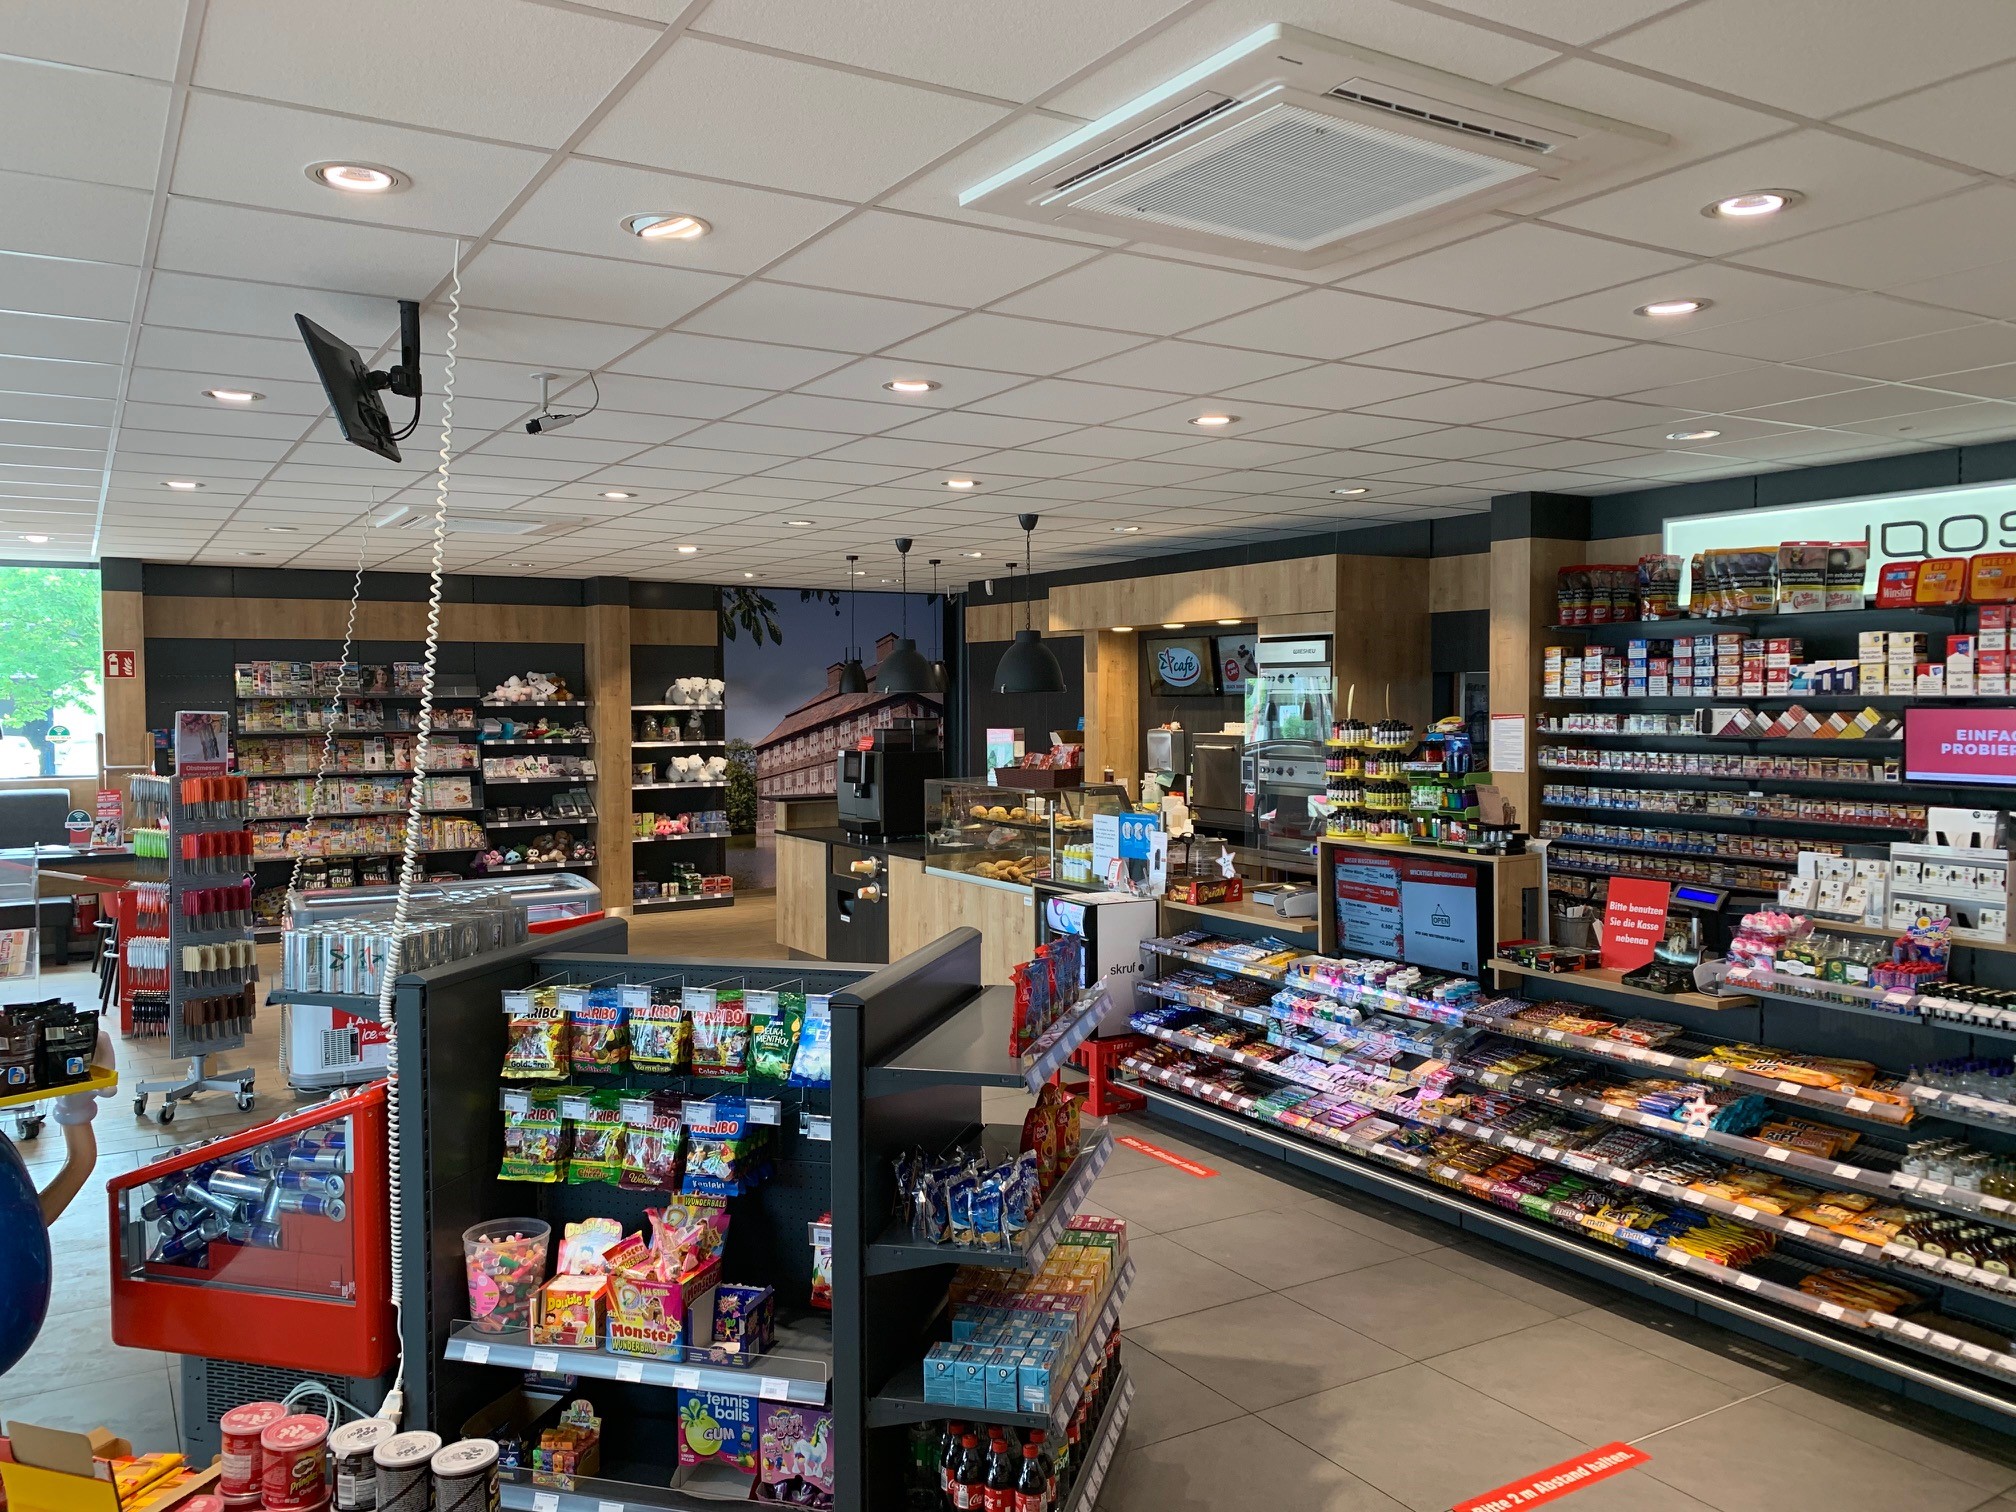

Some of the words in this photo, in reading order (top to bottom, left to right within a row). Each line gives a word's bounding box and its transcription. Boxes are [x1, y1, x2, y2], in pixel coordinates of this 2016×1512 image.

[1883, 586, 1912, 598] Winston
[1174, 655, 1195, 677] café
[1434, 871, 1468, 879] INFORMATION
[1233, 884, 1240, 893] 2
[1610, 901, 1628, 911] Bitte
[1629, 903, 1664, 915] benutzen
[1610, 917, 1621, 926] Sie
[1623, 918, 1636, 928] die
[1637, 920, 1659, 931] Kasse
[1616, 934, 1649, 945] nebenan
[1110, 962, 1137, 976] skruf
[576, 1006, 617, 1020] HARIBO
[633, 1004, 680, 1019] HARIBO
[692, 1008, 744, 1024] HARIBO
[756, 1034, 789, 1047] MENTHOL
[511, 1108, 557, 1121] RIBO
[690, 1121, 739, 1134] HARIBO
[1490, 1185, 1514, 1194] Balisto
[1519, 1176, 1543, 1190] Balisto
[684, 1197, 727, 1208] WUNDERBALL
[1520, 1195, 1544, 1205] Balisto
[565, 1222, 600, 1238] Double
[602, 1222, 621, 1236] Dip
[687, 1273, 717, 1300] Monster
[547, 1294, 583, 1311] Double
[584, 1336, 593, 1344] 24
[611, 1323, 677, 1344] Monster
[611, 1338, 657, 1355] WUNDERBALL
[706, 1391, 750, 1409] tennis
[715, 1406, 750, 1422] balls
[704, 1427, 735, 1441] GUM
[289, 1471, 318, 1495] Pringles
[1471, 1496, 1513, 1512] Bitte
[1507, 1493, 1524, 1504] 2
[1519, 1488, 1539, 1500] m
[1532, 1466, 1592, 1494] Abstand
[1584, 1451, 1635, 1473] halten.
